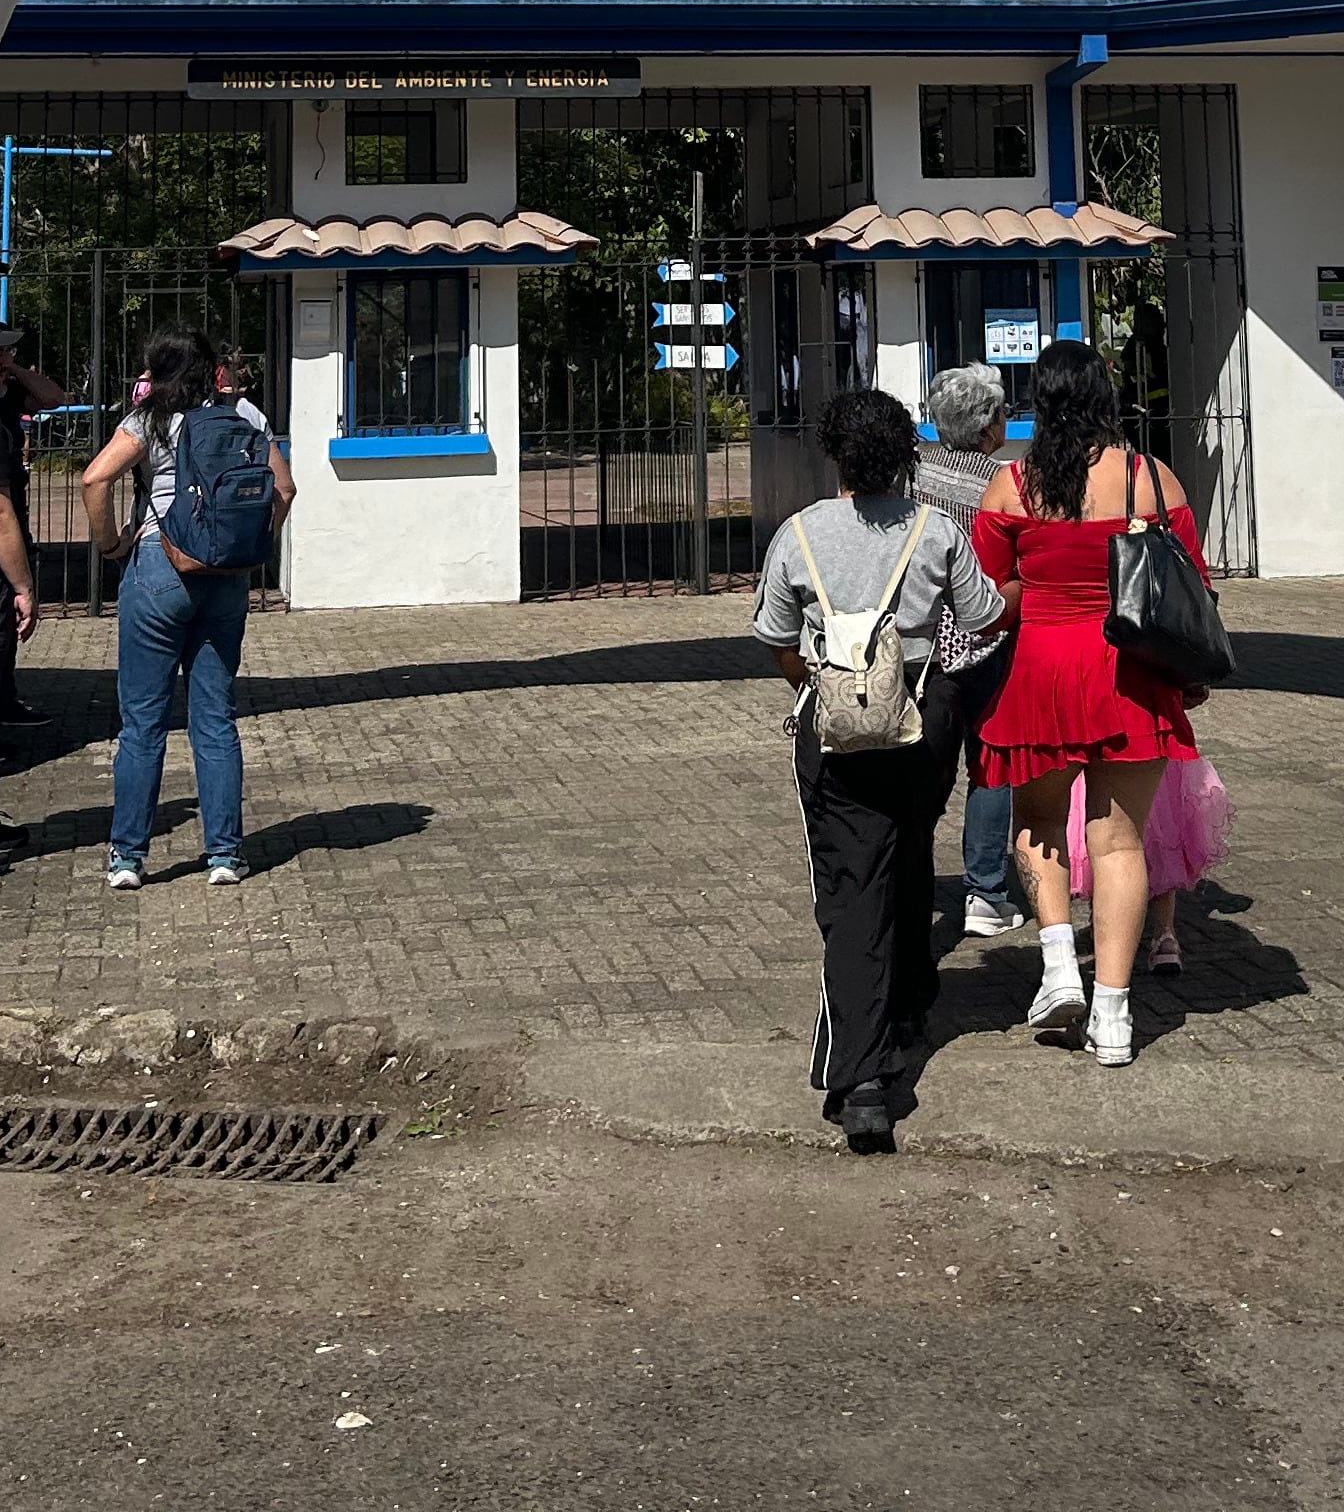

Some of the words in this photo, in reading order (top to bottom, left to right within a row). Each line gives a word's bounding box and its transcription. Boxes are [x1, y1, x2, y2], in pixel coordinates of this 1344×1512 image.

[222, 70, 335, 89] MINISTERIO
[344, 70, 383, 89] DEL
[394, 69, 492, 88] AMBIENTE
[504, 69, 516, 88] Y
